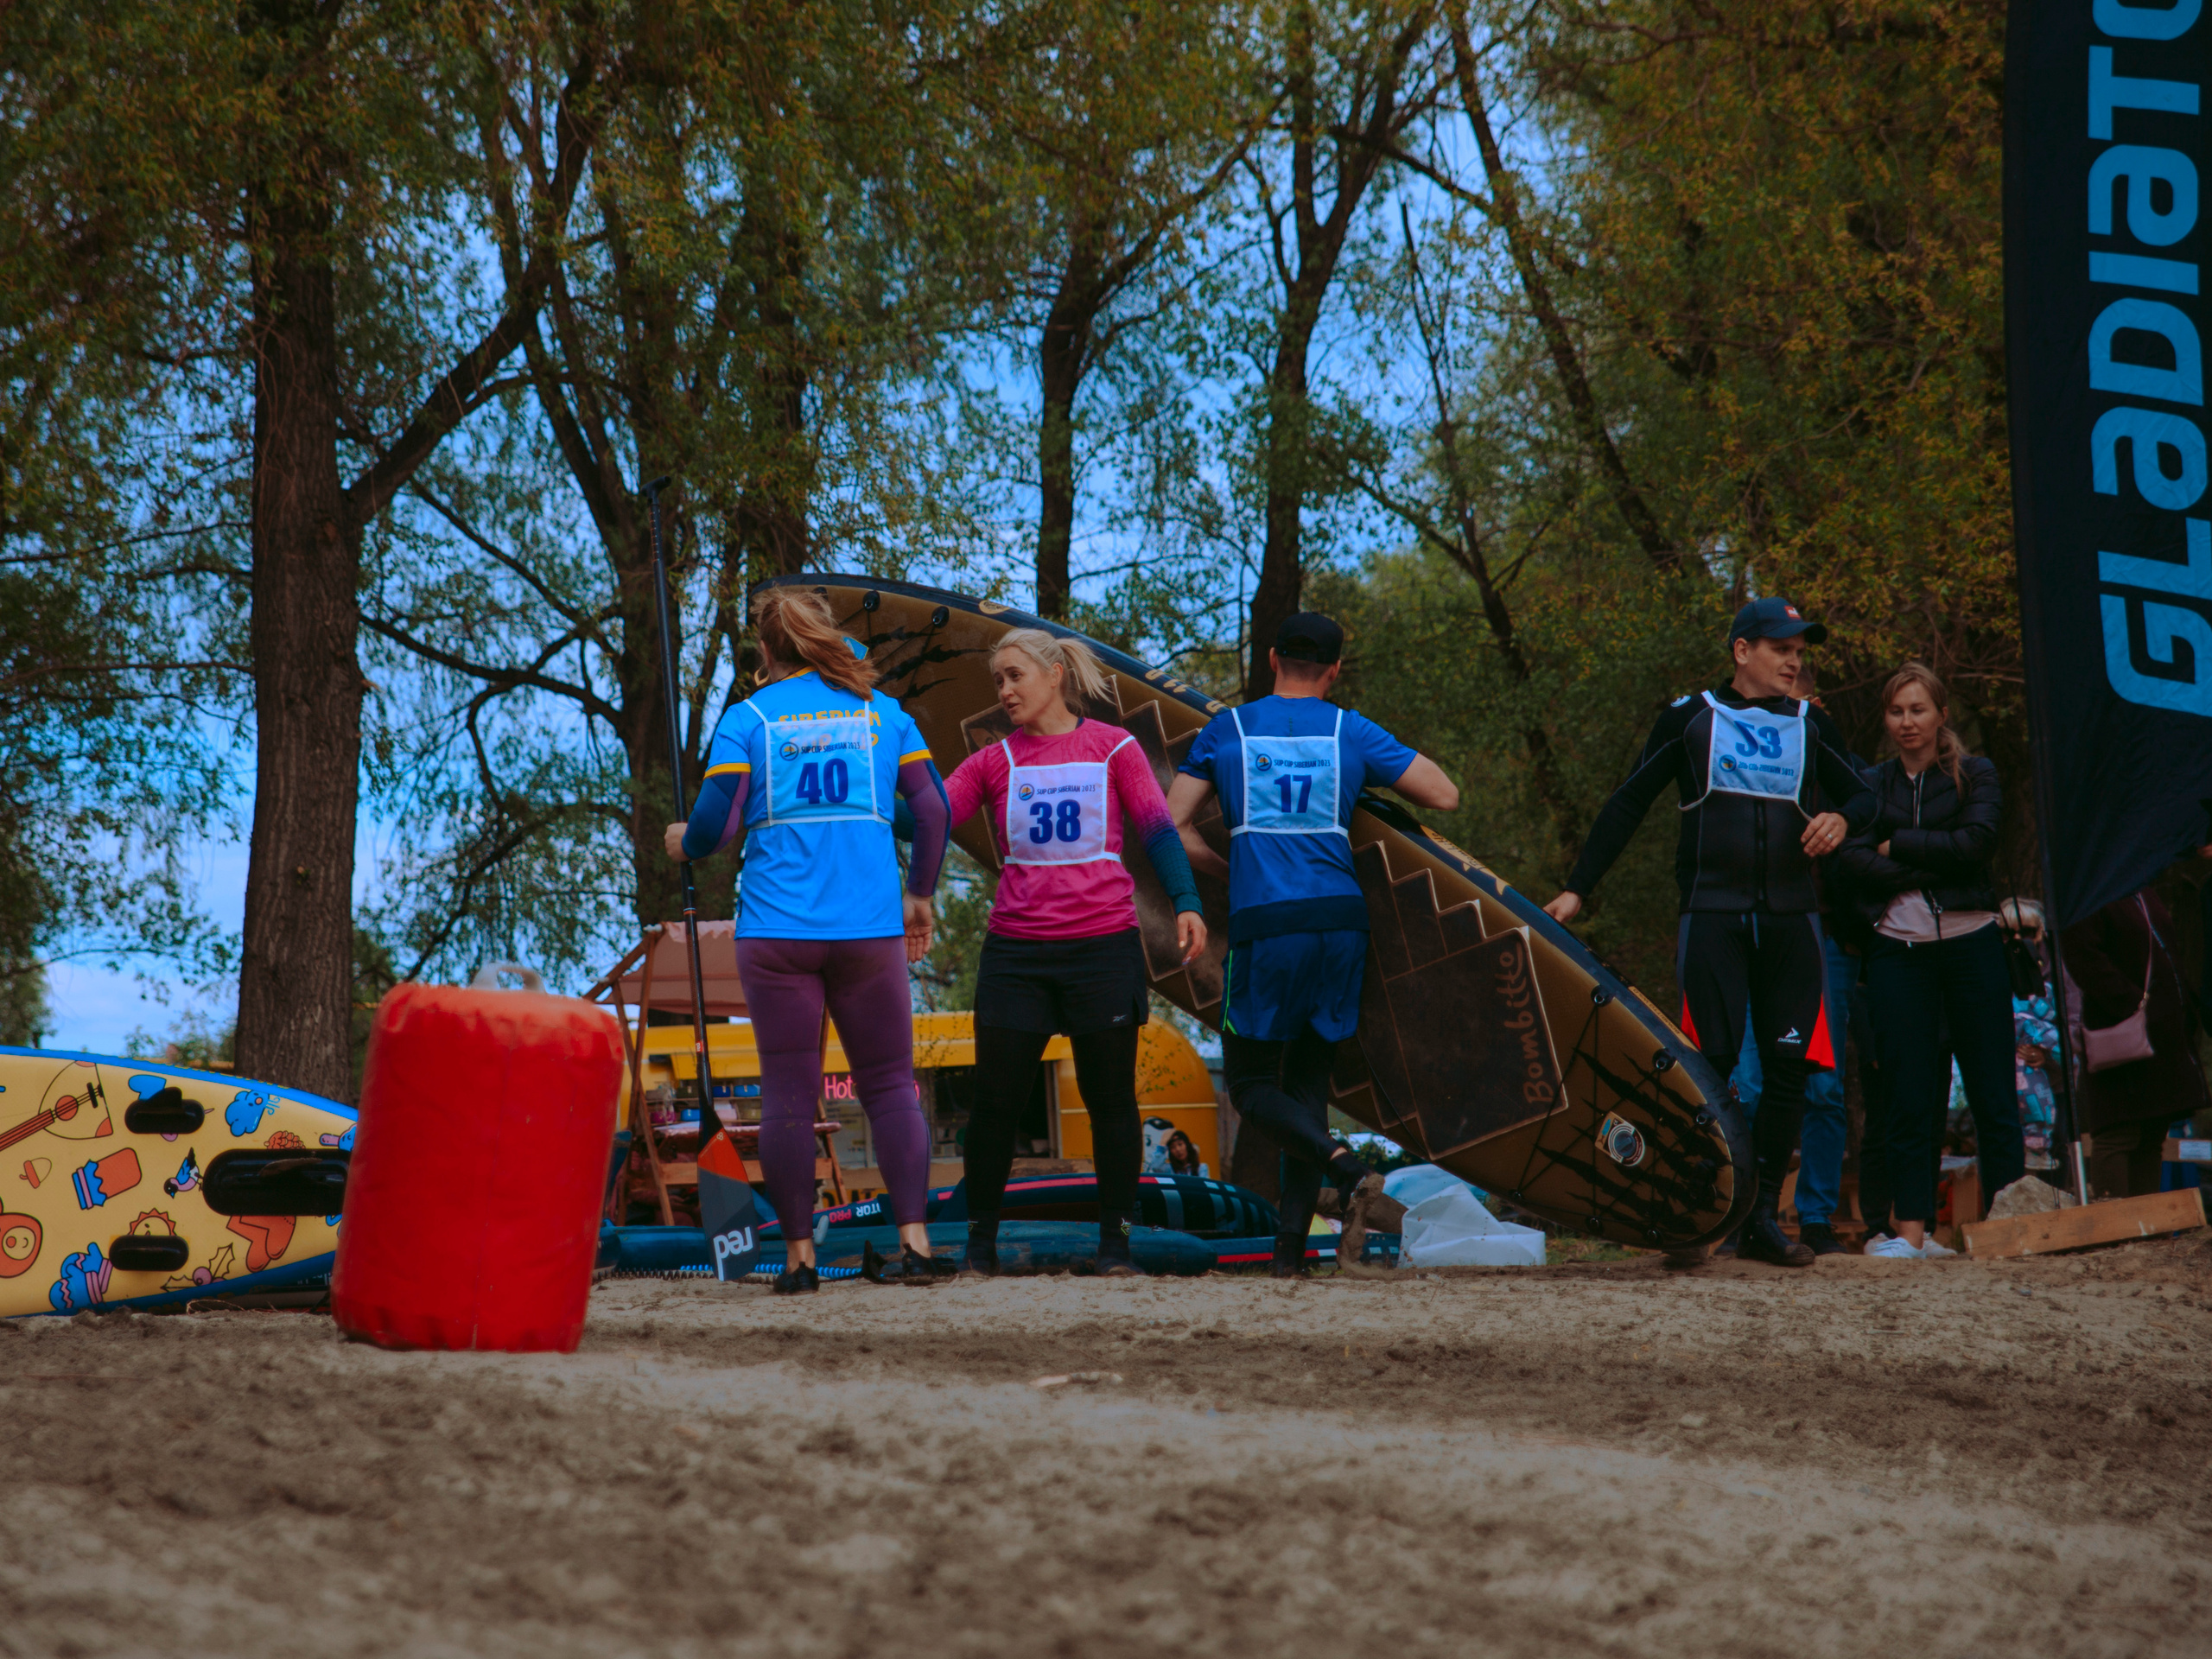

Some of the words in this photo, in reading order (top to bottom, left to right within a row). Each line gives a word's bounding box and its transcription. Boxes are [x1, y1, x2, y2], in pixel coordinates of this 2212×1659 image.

[801, 746, 811, 754] SUP
[823, 743, 848, 752] SIBERIAN
[796, 759, 849, 804] 40
[1058, 785, 1081, 793] SIBERIAN
[1274, 773, 1312, 813] 17
[1029, 799, 1081, 844] 38
[1495, 943, 1554, 1104] Bombitto
[824, 1074, 855, 1100] Hot
[829, 1208, 852, 1224] PRO
[713, 1226, 754, 1281] red
